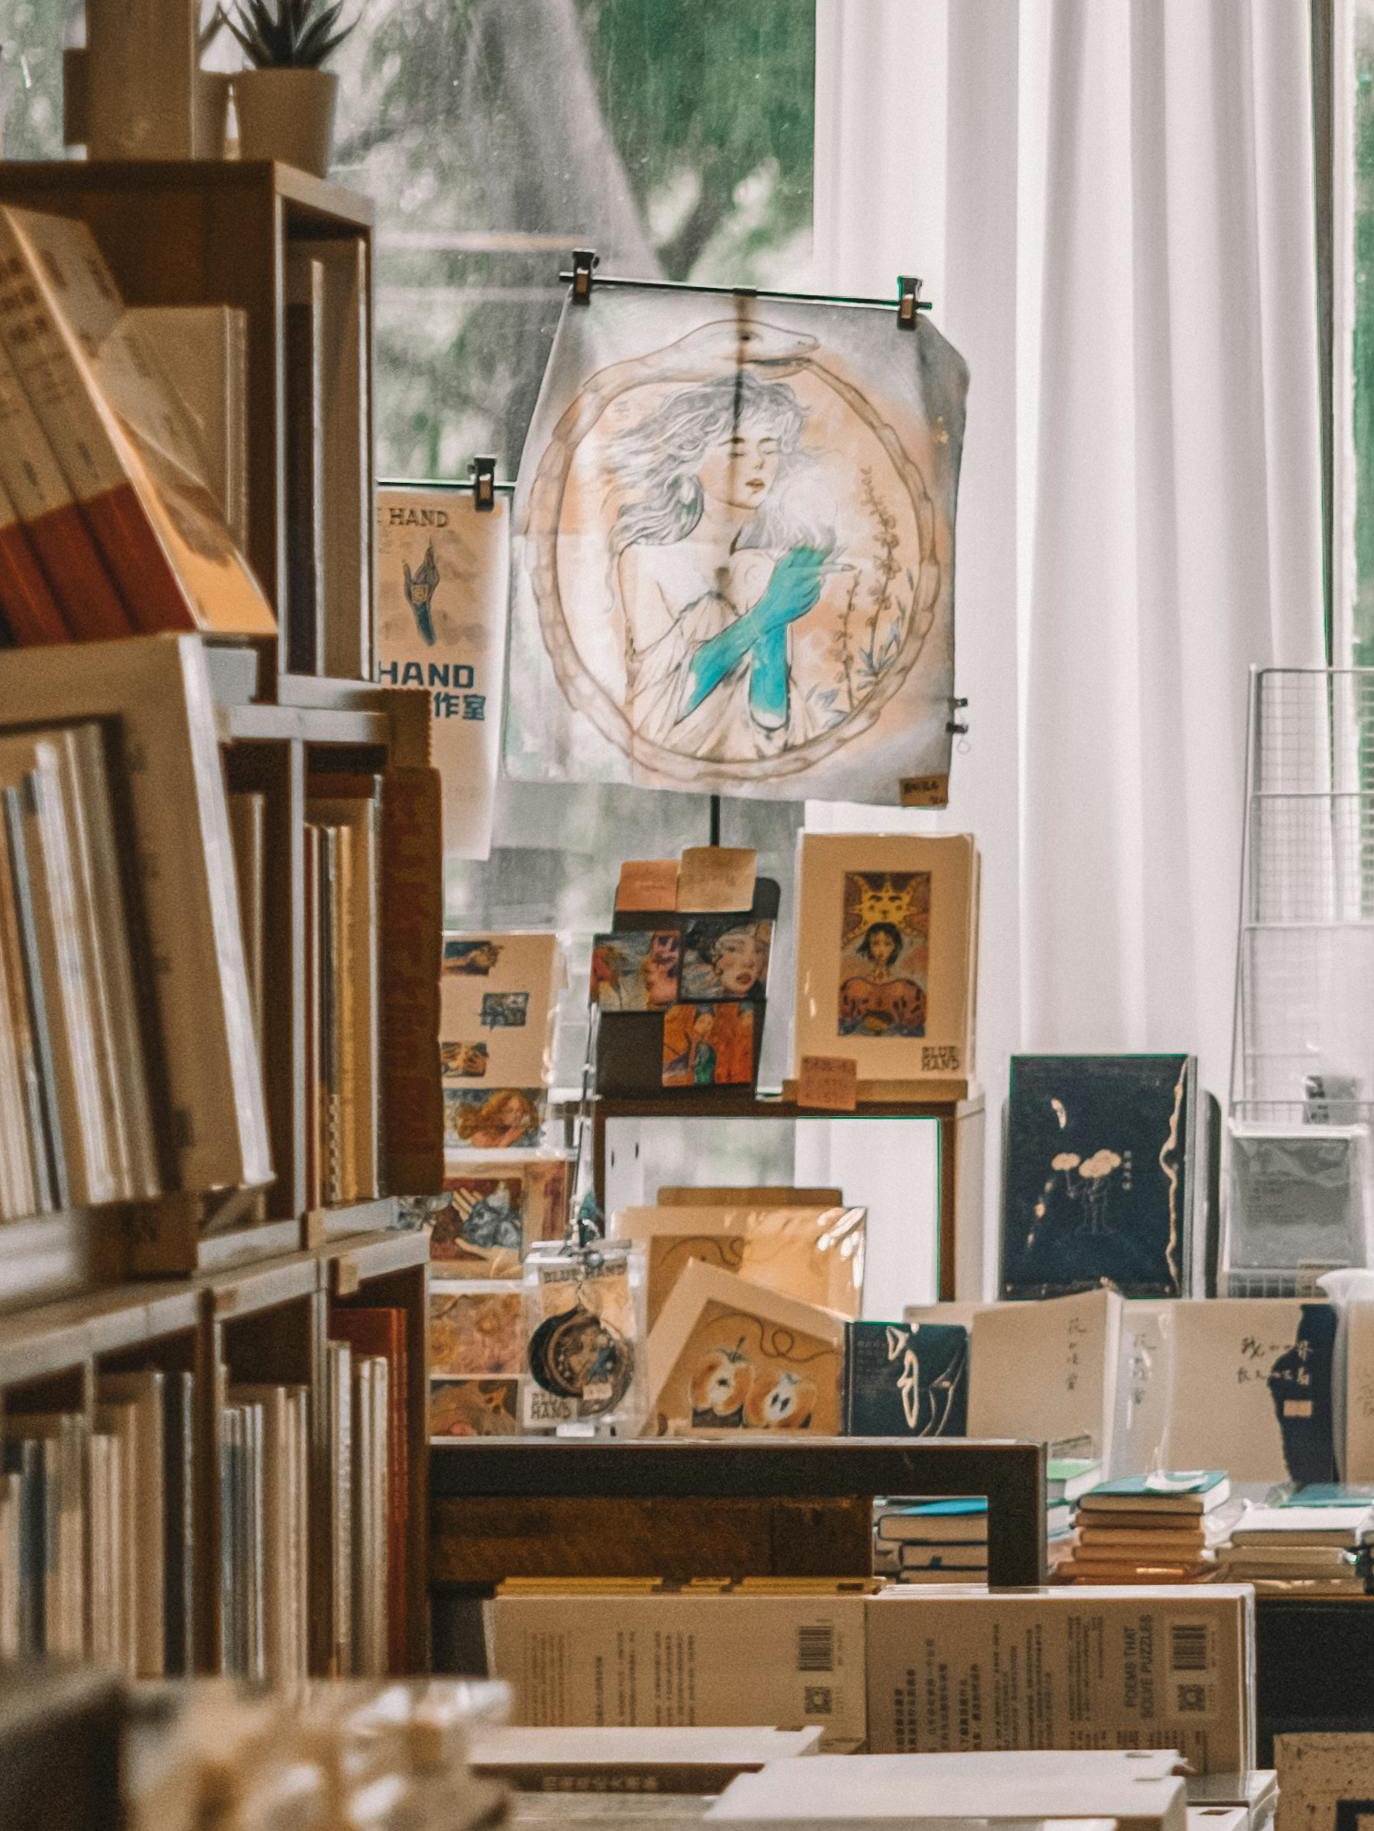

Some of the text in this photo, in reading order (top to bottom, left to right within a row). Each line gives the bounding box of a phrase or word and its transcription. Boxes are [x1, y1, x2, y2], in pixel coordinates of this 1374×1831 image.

[388, 506, 449, 529] HAND
[378, 660, 475, 690] HAND
[1139, 1614, 1154, 1674] PUZZLES
[1123, 1626, 1137, 1708] POEMS THAT
